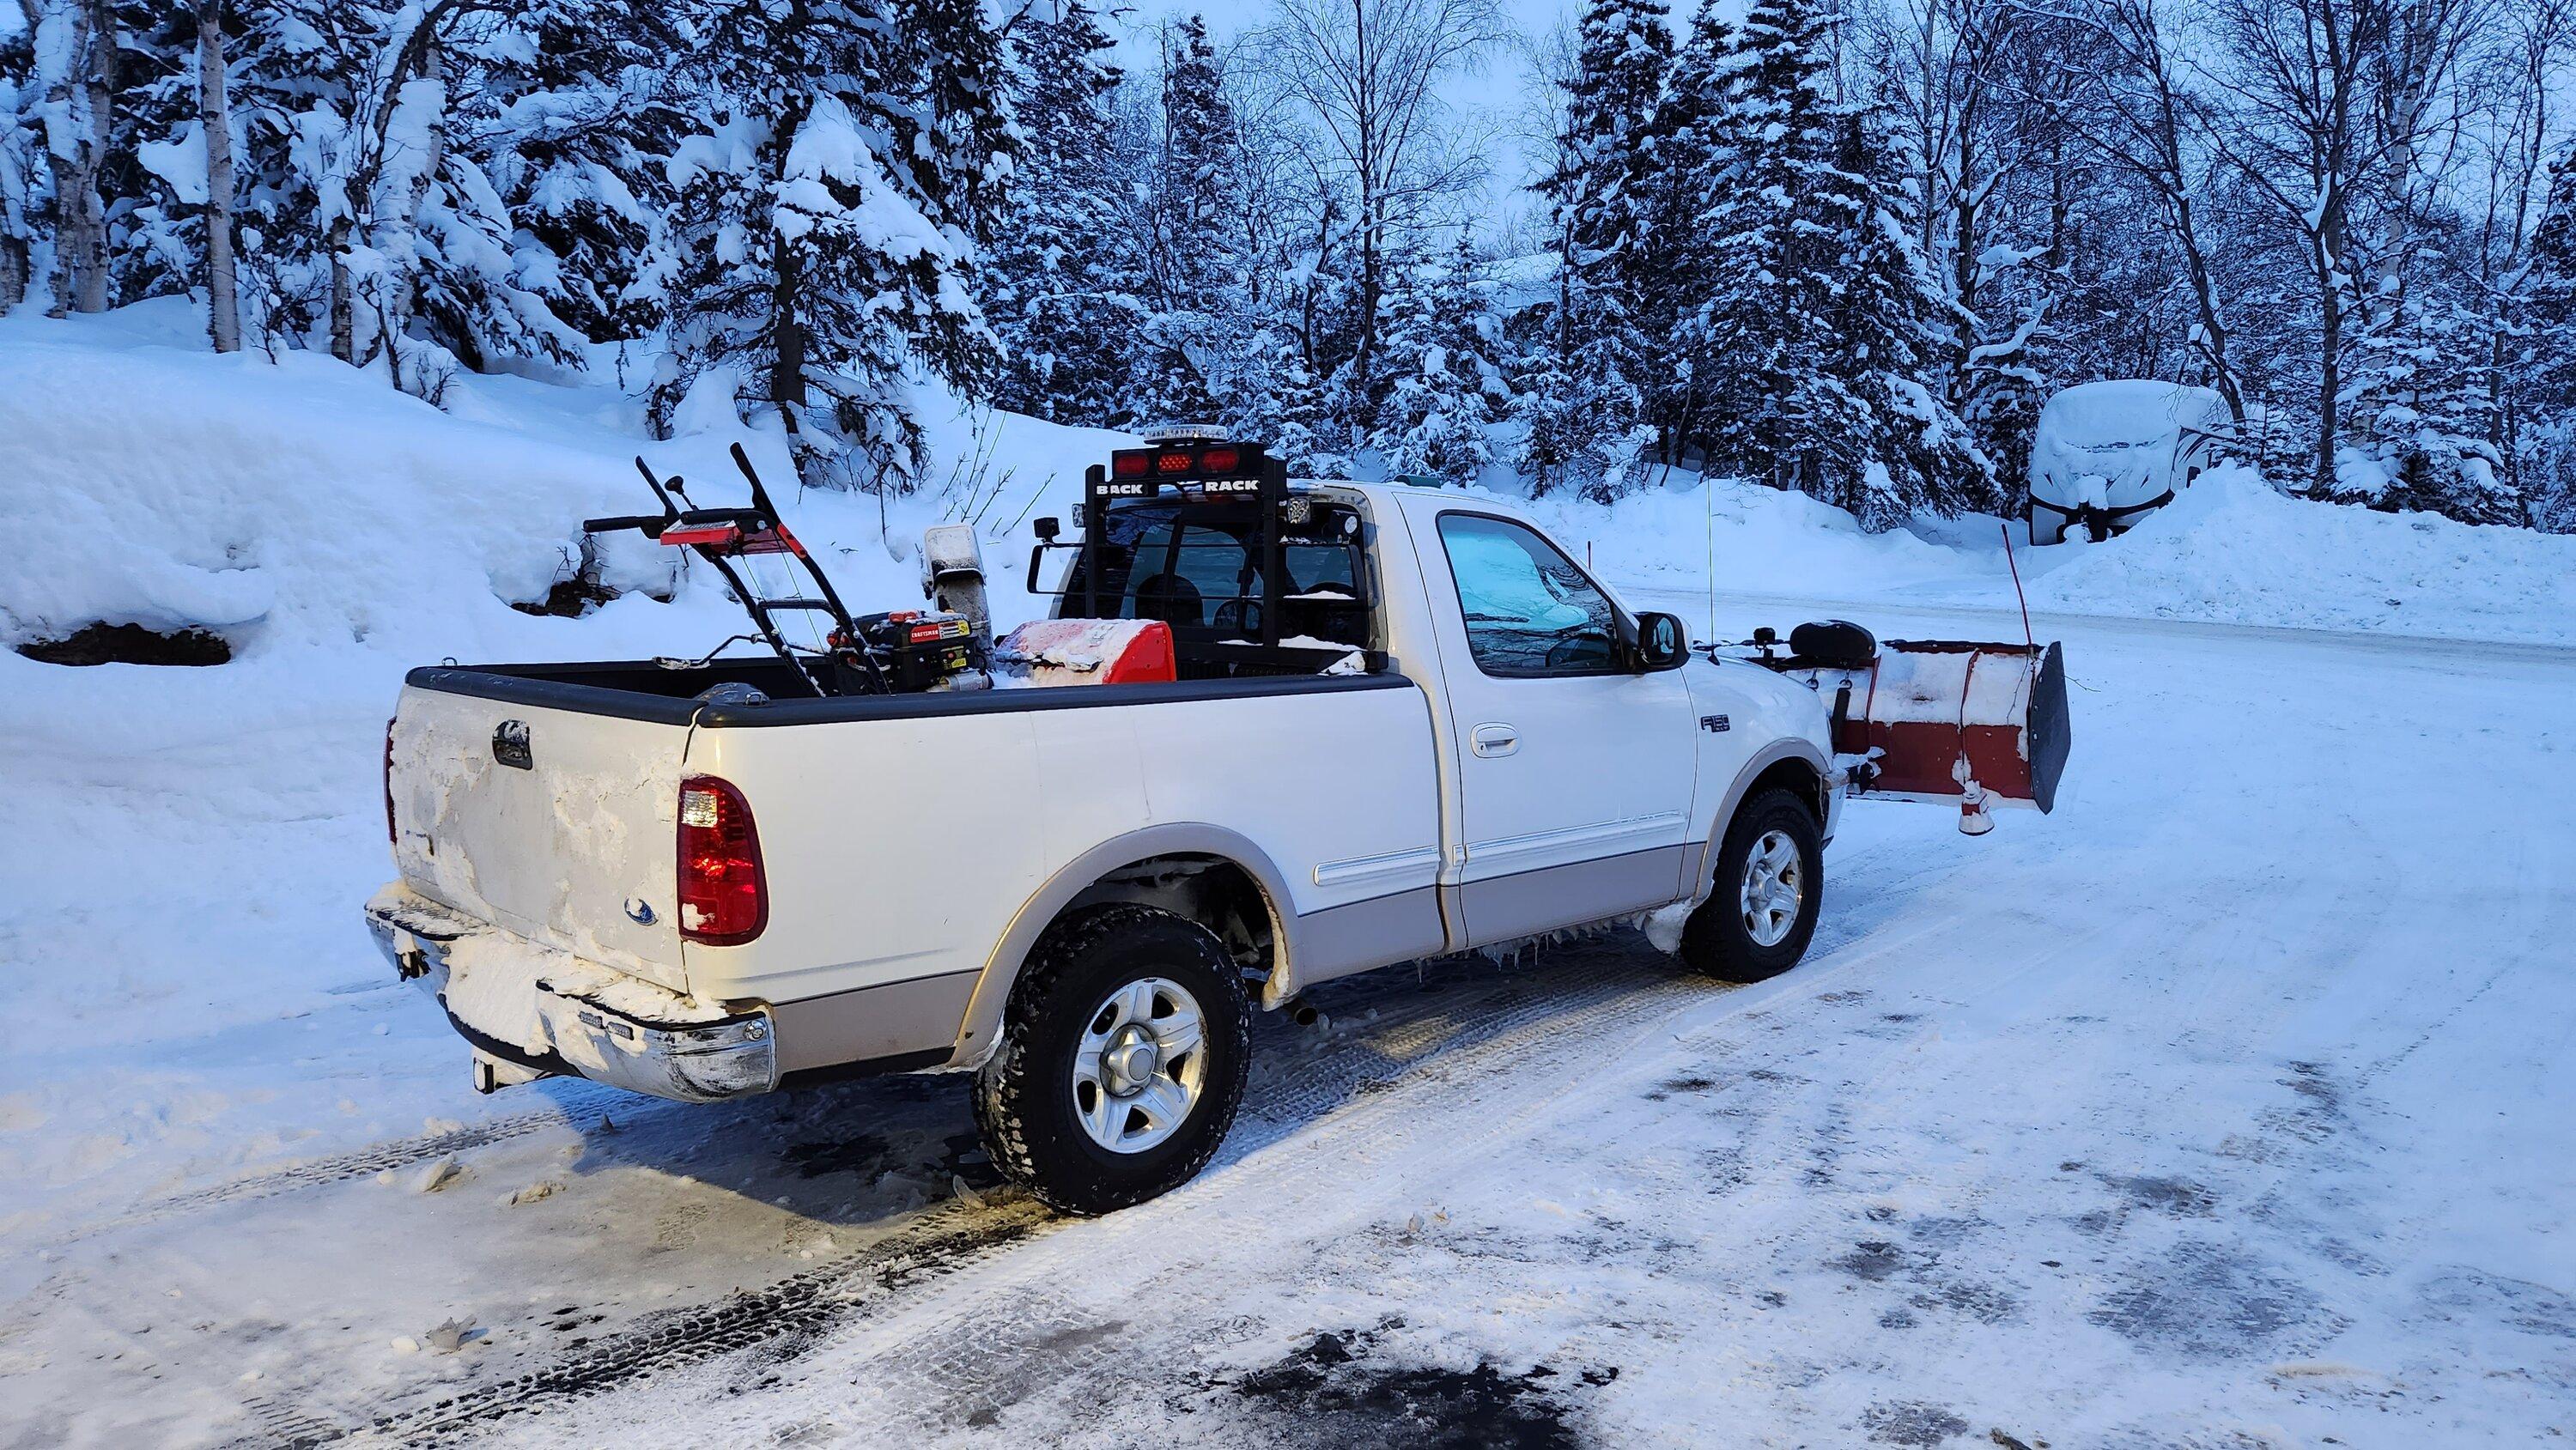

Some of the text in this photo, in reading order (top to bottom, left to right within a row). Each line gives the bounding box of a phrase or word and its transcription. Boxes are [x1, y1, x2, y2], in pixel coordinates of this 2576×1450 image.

[1097, 480, 1259, 494] BACK RACK
[911, 629, 939, 638] CRAFTSMAN
